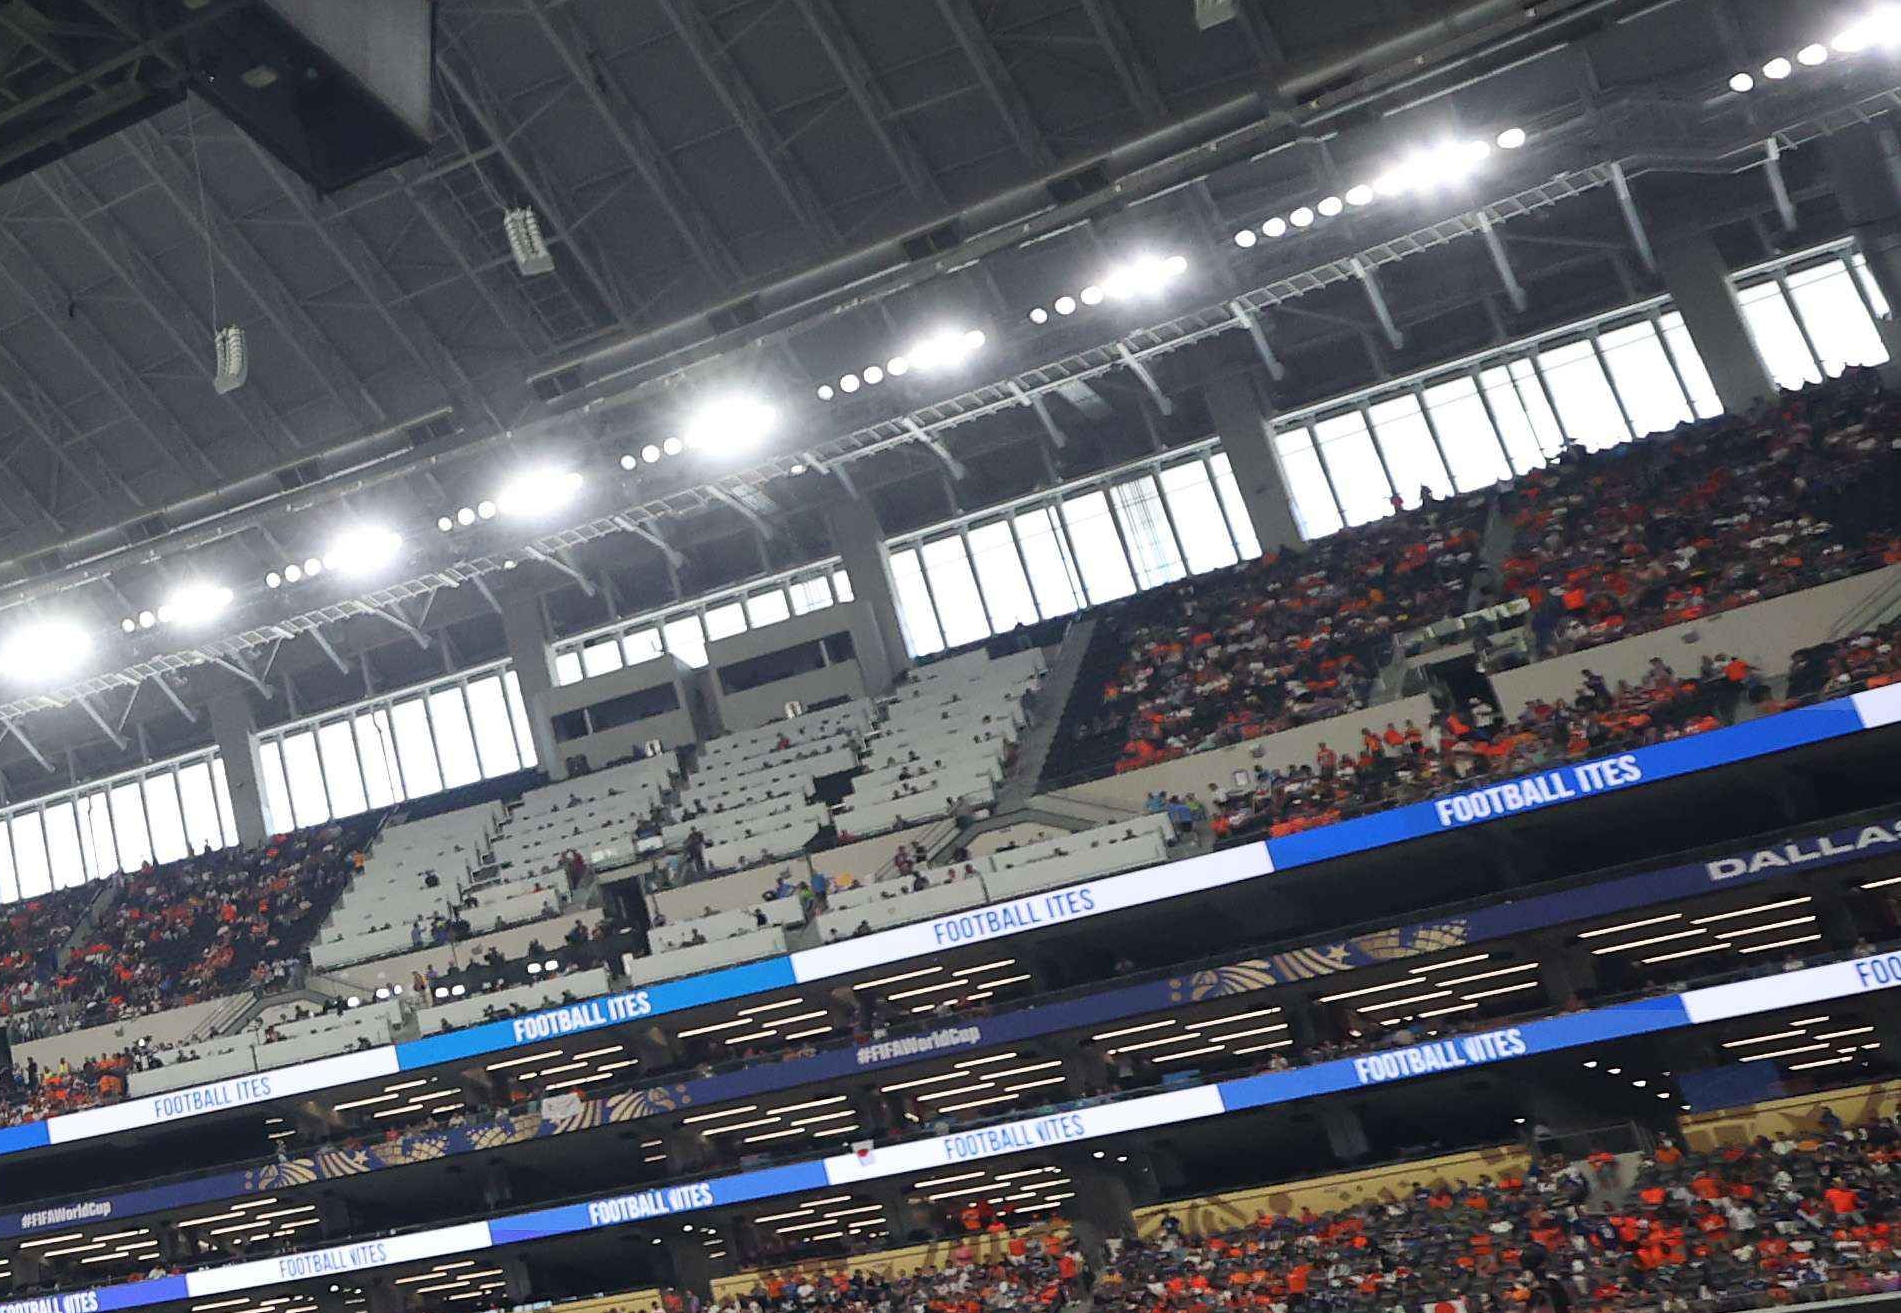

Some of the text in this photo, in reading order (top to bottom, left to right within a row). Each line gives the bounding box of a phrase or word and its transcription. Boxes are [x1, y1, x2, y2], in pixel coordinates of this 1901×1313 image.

[1436, 771, 1576, 827] FOOTBALL
[1704, 822, 1901, 882] DALLA
[934, 900, 1040, 946] FOOTBALL
[513, 1001, 607, 1042] FOOTBALL
[857, 1026, 981, 1066] #FIFAWorldCup
[1354, 1040, 1465, 1084] FOOTBALL
[154, 1090, 230, 1118] FOOTBALL
[943, 1126, 1033, 1160] FOOTBALL
[21, 1201, 112, 1230] #FIFAWorldCup
[588, 1190, 668, 1224] FOOTBALL
[279, 1253, 347, 1278] FOOTBALL
